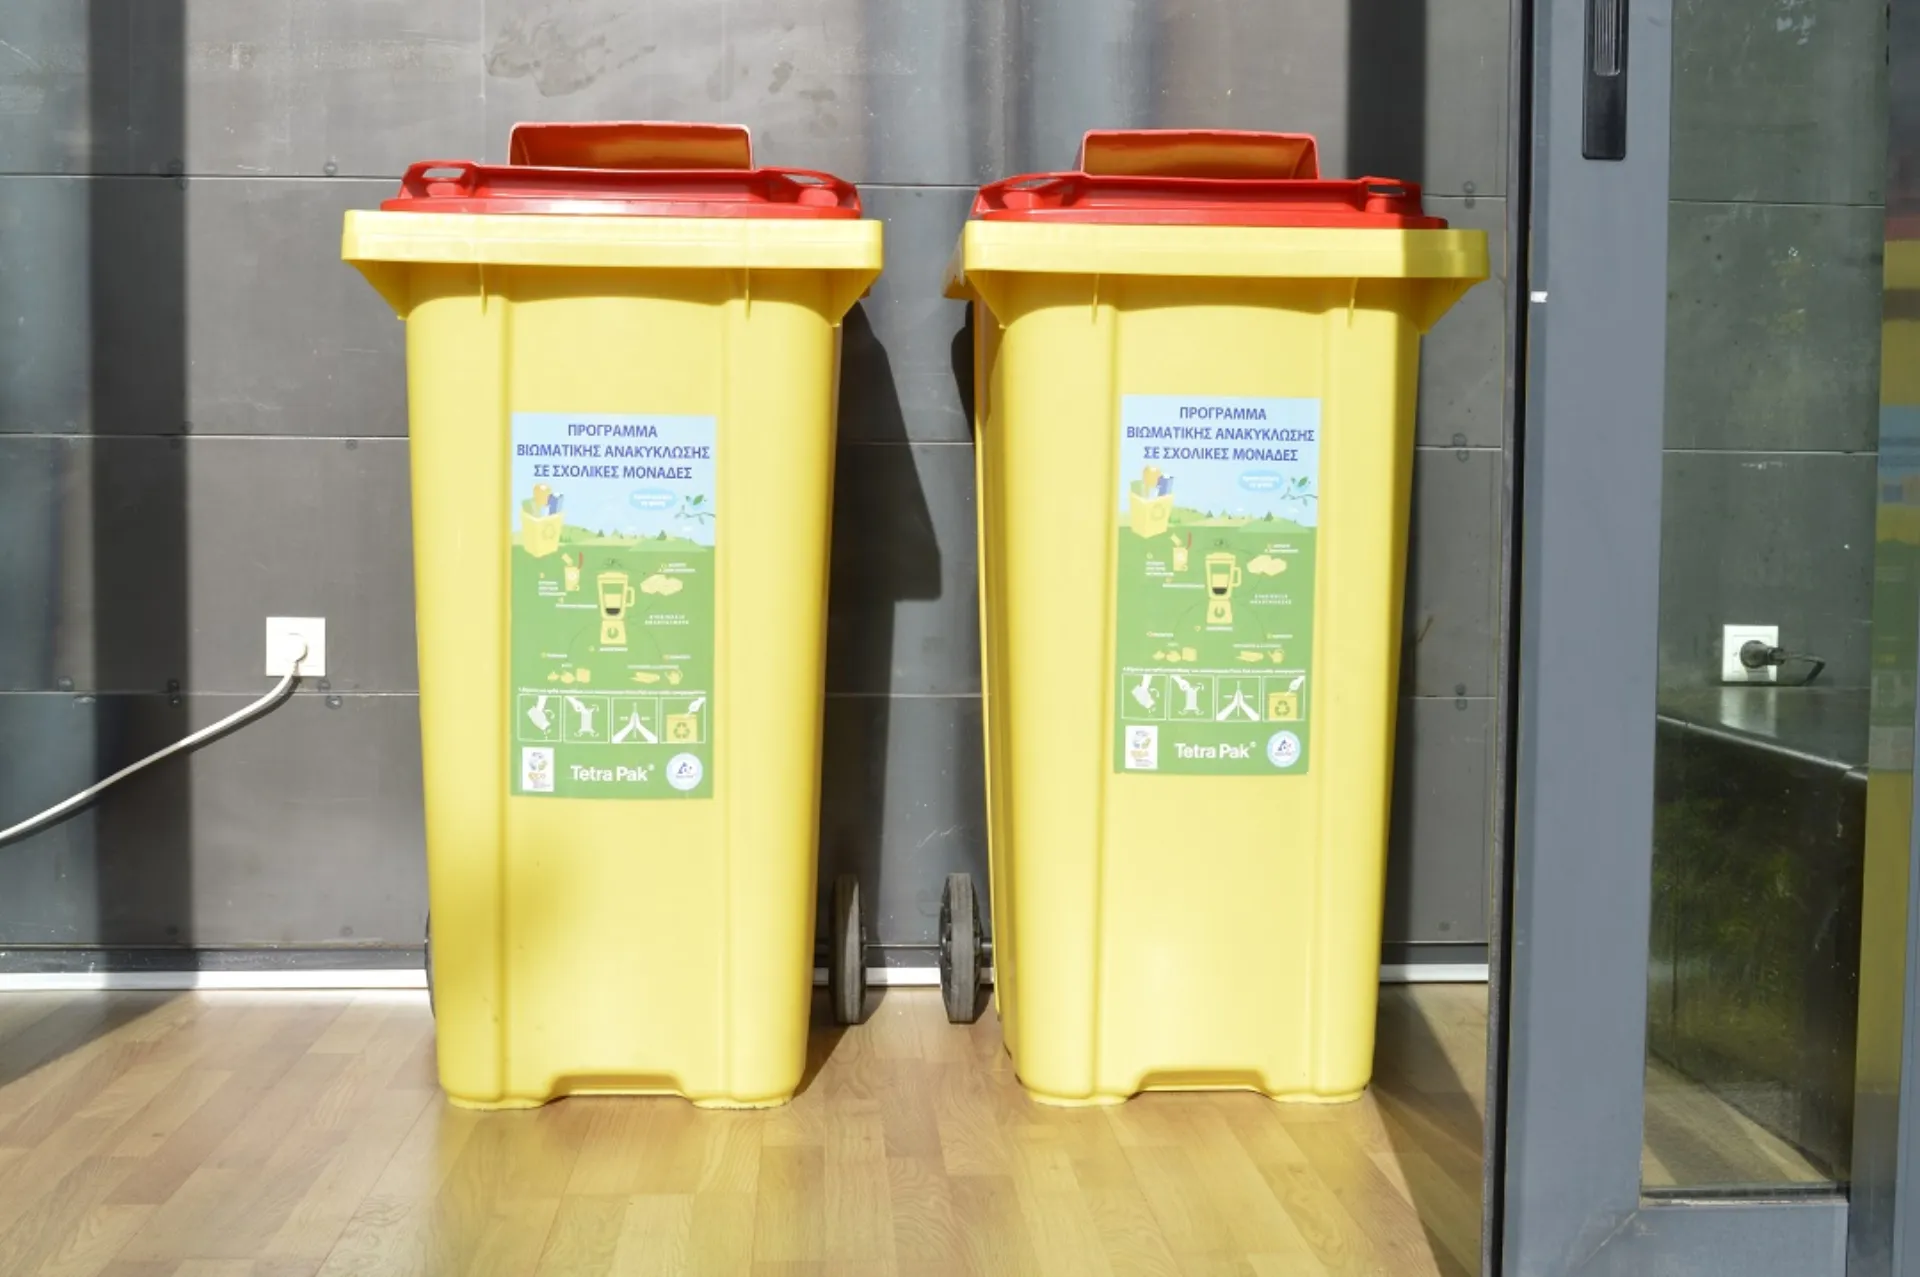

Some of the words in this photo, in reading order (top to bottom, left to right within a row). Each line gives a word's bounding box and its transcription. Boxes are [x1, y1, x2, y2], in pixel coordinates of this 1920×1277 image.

[1179, 406, 1267, 421] ΠΡΟΓΡΑΜΜΑ
[567, 423, 658, 438] ΠΡΟΓΡΑΜΜΑ
[1126, 426, 1212, 440] ΒΙΩΜΑΤΙΚΗΣ
[1215, 427, 1315, 442] ΑΝΑΚΥΚΛΩΣΗΣ
[516, 443, 602, 458] ΒΙΩΜΑΤΙΚΗΣ
[604, 444, 711, 459] ΑΝΑΚΥΚΛΩΣΗΣ
[1143, 446, 1160, 459] ΣΕ
[1162, 446, 1229, 460] ΣΧΟΛΙΚΕΣ
[1232, 447, 1298, 461] ΜΟΝΑΔΕΣ
[533, 464, 550, 478] ΣΕ
[552, 464, 619, 479] ΣΧΟΛΙΚΕΣ
[622, 466, 692, 479] ΜΟΝΑΔΕΣ
[1174, 742, 1216, 759] Tetra
[570, 765, 613, 782] Tetra
